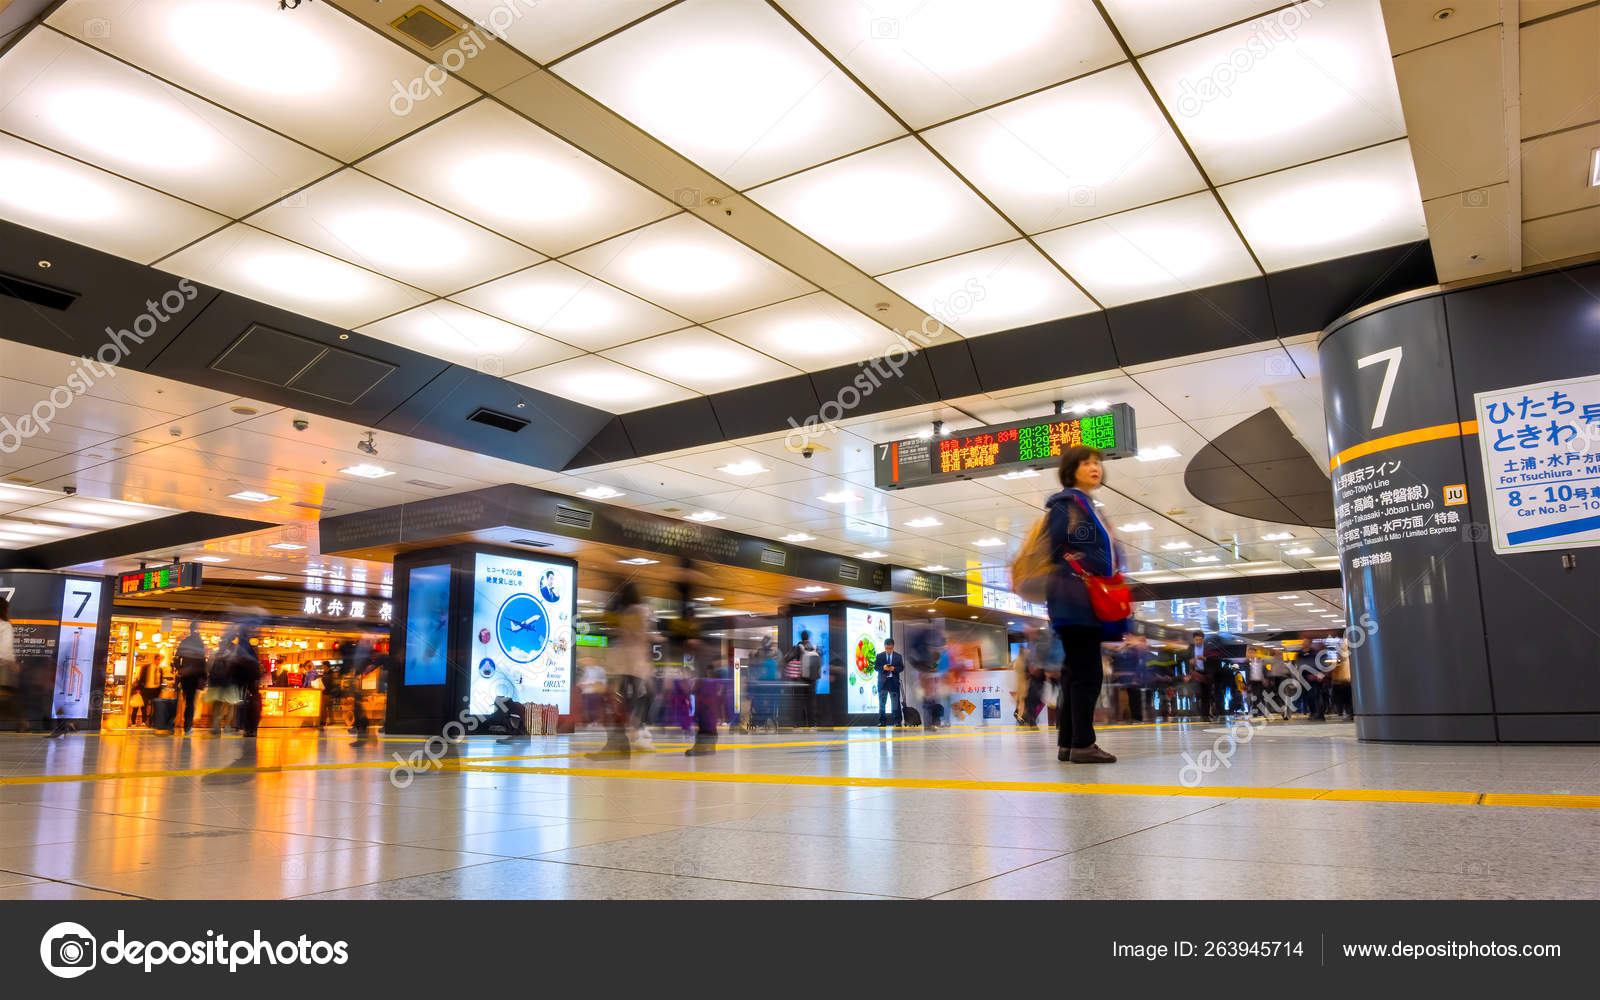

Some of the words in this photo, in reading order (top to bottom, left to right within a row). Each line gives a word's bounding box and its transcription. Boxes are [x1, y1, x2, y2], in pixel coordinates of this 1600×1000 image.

[1357, 346, 1403, 430] 7
[1486, 391, 1575, 424] ひたち
[965, 433, 993, 449] ときわ
[997, 429, 1018, 443] 83号
[1019, 424, 1049, 440] 20:23
[1049, 419, 1081, 434] いわき
[1493, 420, 1578, 452] ときわ
[1020, 435, 1050, 450] 20:29
[879, 444, 889, 461] 7
[1020, 447, 1051, 461] 20:38
[1373, 479, 1391, 489] Line
[1500, 474, 1517, 484] For
[1520, 469, 1573, 482] Tsuchiura
[1446, 488, 1463, 501] JU
[1508, 490, 1522, 507] 8
[1517, 506, 1536, 517] Car
[1406, 528, 1428, 538] Limited
[1429, 525, 1457, 537] Express
[72, 590, 92, 619] 7
[652, 645, 663, 661] 5
